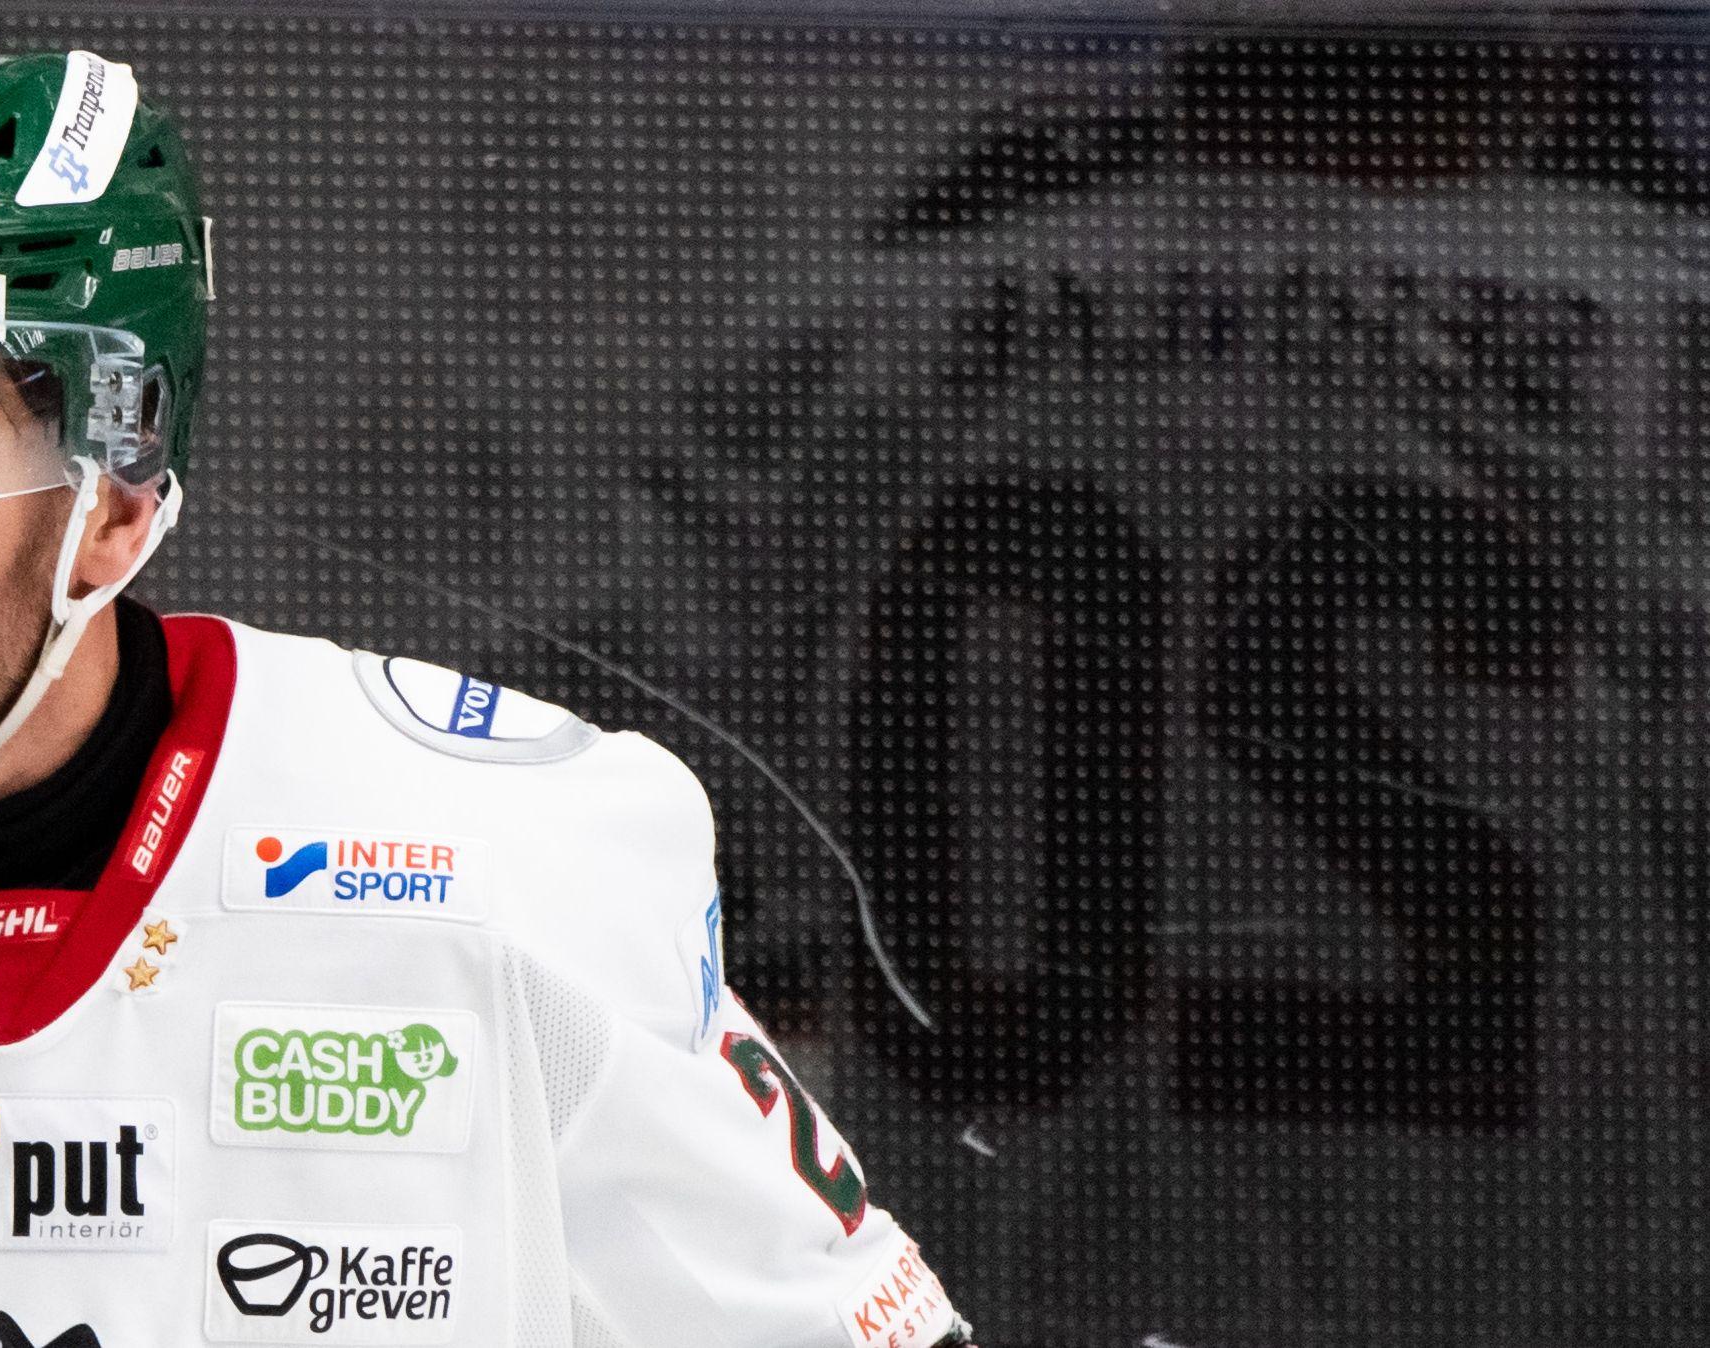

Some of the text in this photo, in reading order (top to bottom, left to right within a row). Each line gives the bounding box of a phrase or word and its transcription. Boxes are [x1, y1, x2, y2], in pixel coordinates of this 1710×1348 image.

[131, 751, 192, 876] BAUER
[337, 839, 454, 872] INTER
[334, 870, 454, 903] SPORT
[242, 1036, 384, 1084] CASH
[242, 1081, 420, 1129] BUDDY
[40, 1222, 144, 1238] interiör
[340, 1246, 453, 1286] Kaffe
[309, 1288, 451, 1333] greven
